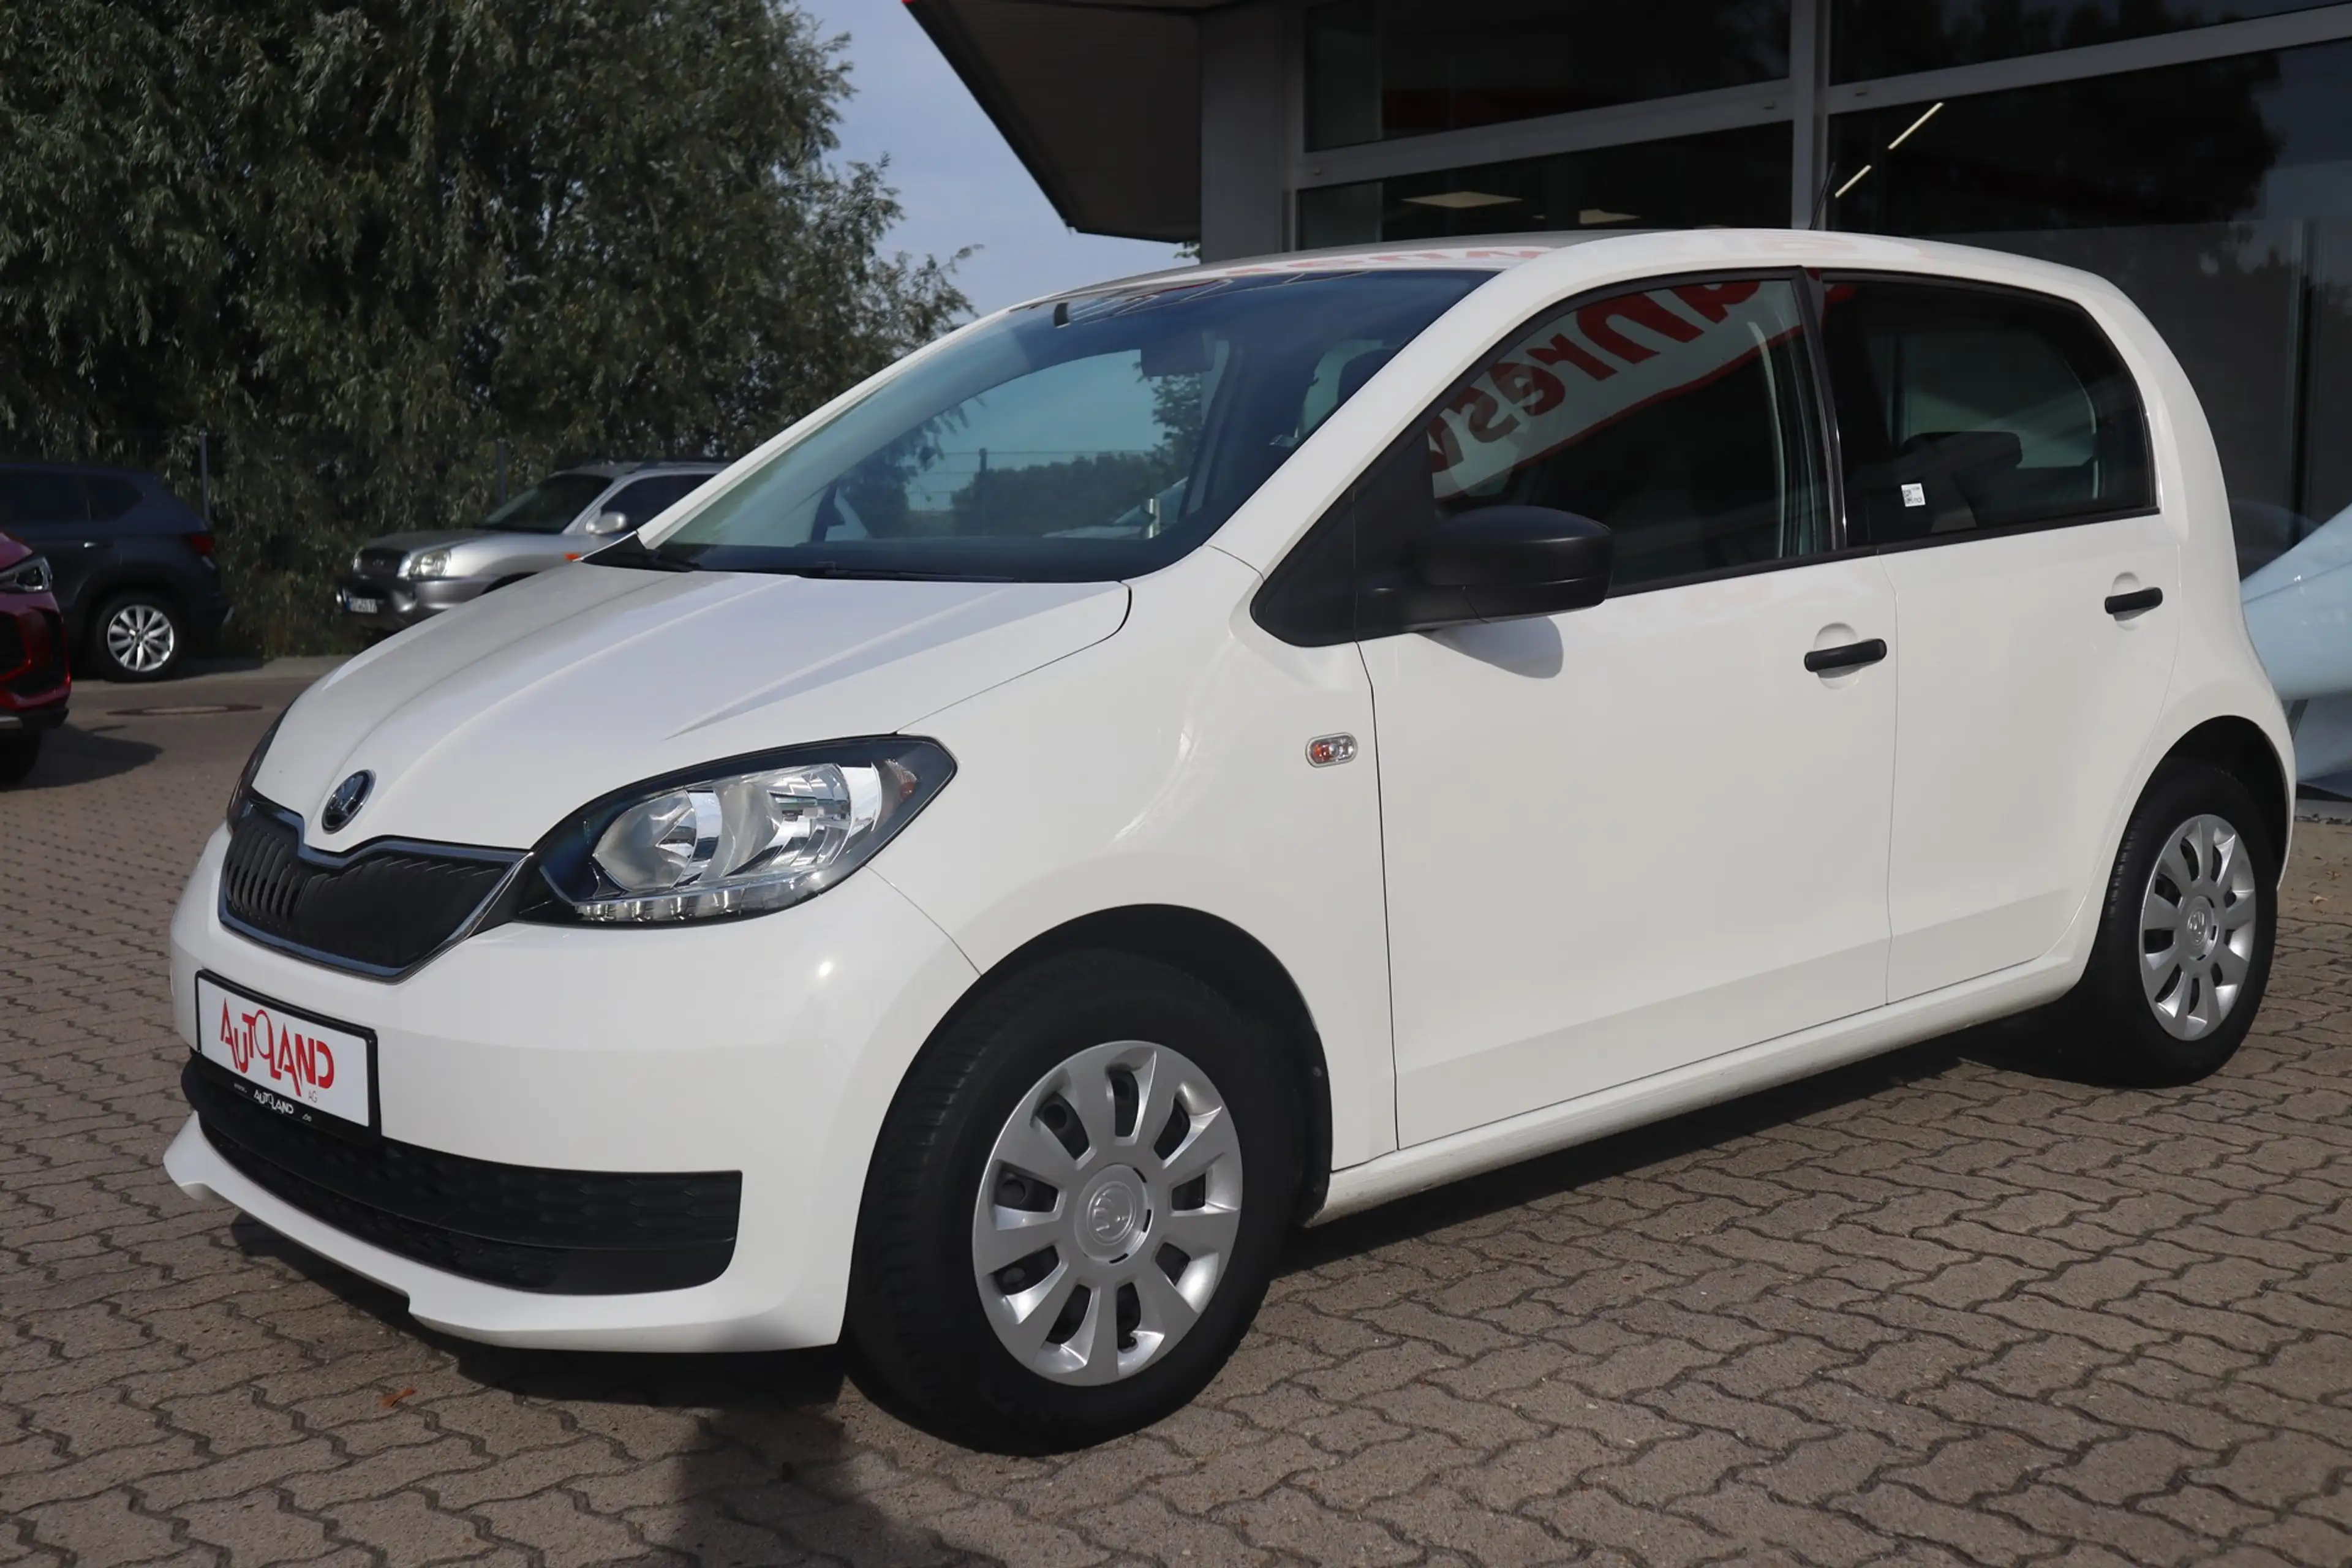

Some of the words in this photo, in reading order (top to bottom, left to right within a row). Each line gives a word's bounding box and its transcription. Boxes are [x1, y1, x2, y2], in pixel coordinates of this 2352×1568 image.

[221, 997, 334, 1097] AUTOLAND
[253, 1090, 294, 1115] AUTOLAND
[307, 1090, 318, 1103] AG
